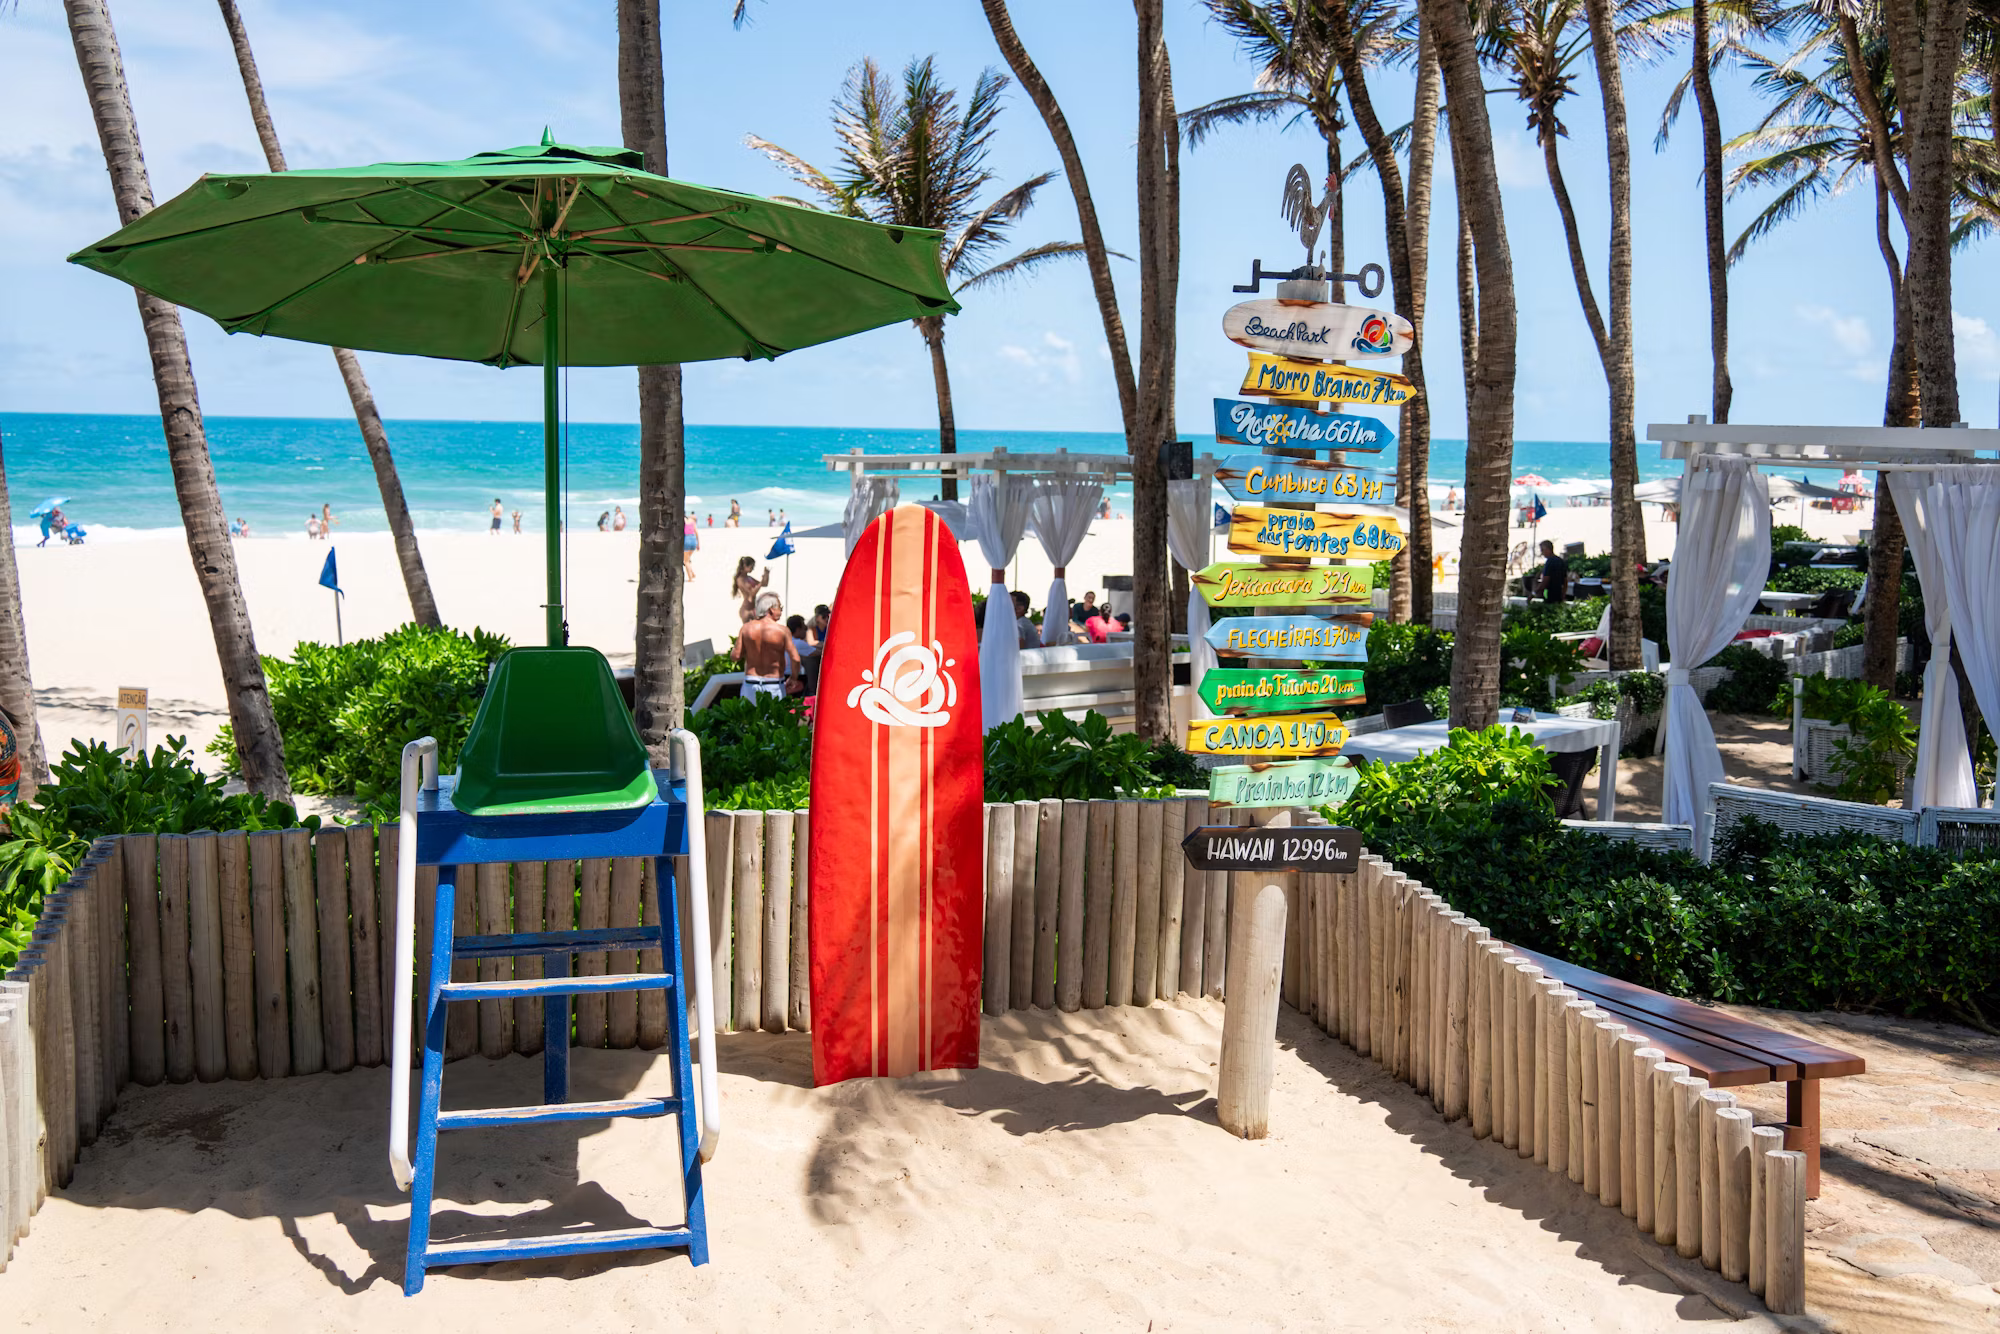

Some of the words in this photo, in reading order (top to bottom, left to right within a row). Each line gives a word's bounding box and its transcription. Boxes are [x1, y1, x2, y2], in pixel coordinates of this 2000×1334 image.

[1245, 316, 1295, 341] Beach
[1296, 321, 1331, 344] Park
[1257, 363, 1310, 393] Morro
[1312, 370, 1371, 399] Branco
[1268, 512, 1315, 531] praia
[1256, 526, 1283, 545] das
[1283, 530, 1350, 555] Fontes
[1214, 679, 1256, 706] praia
[1256, 677, 1274, 698] do
[1272, 673, 1320, 697] Futuro
[1205, 724, 1285, 750] CANOA
[1236, 775, 1306, 804] Prainha
[1207, 837, 1275, 862] HAWAII
